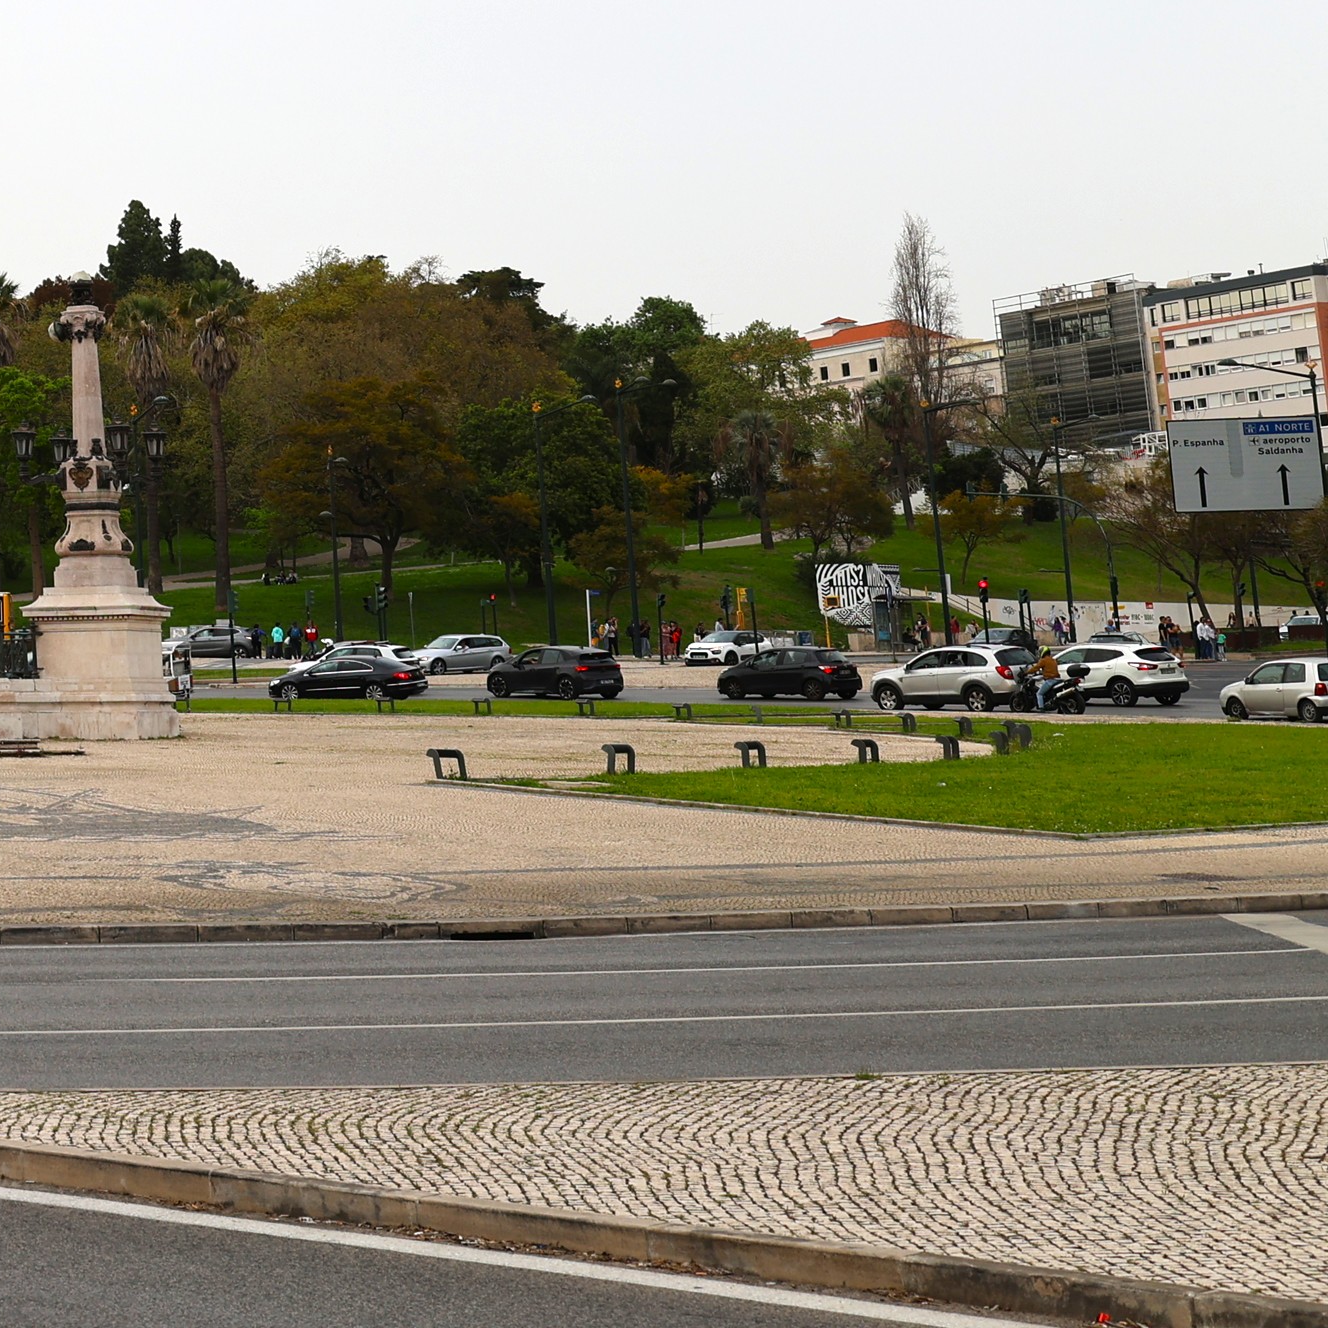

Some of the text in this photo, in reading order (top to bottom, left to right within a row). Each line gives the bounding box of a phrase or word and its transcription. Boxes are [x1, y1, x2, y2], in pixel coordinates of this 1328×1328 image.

[1258, 422, 1311, 432] A1 NORTE
[1172, 438, 1224, 448] P. Espanha
[1262, 436, 1311, 445] aeroporto
[1258, 447, 1304, 455] Saldanha
